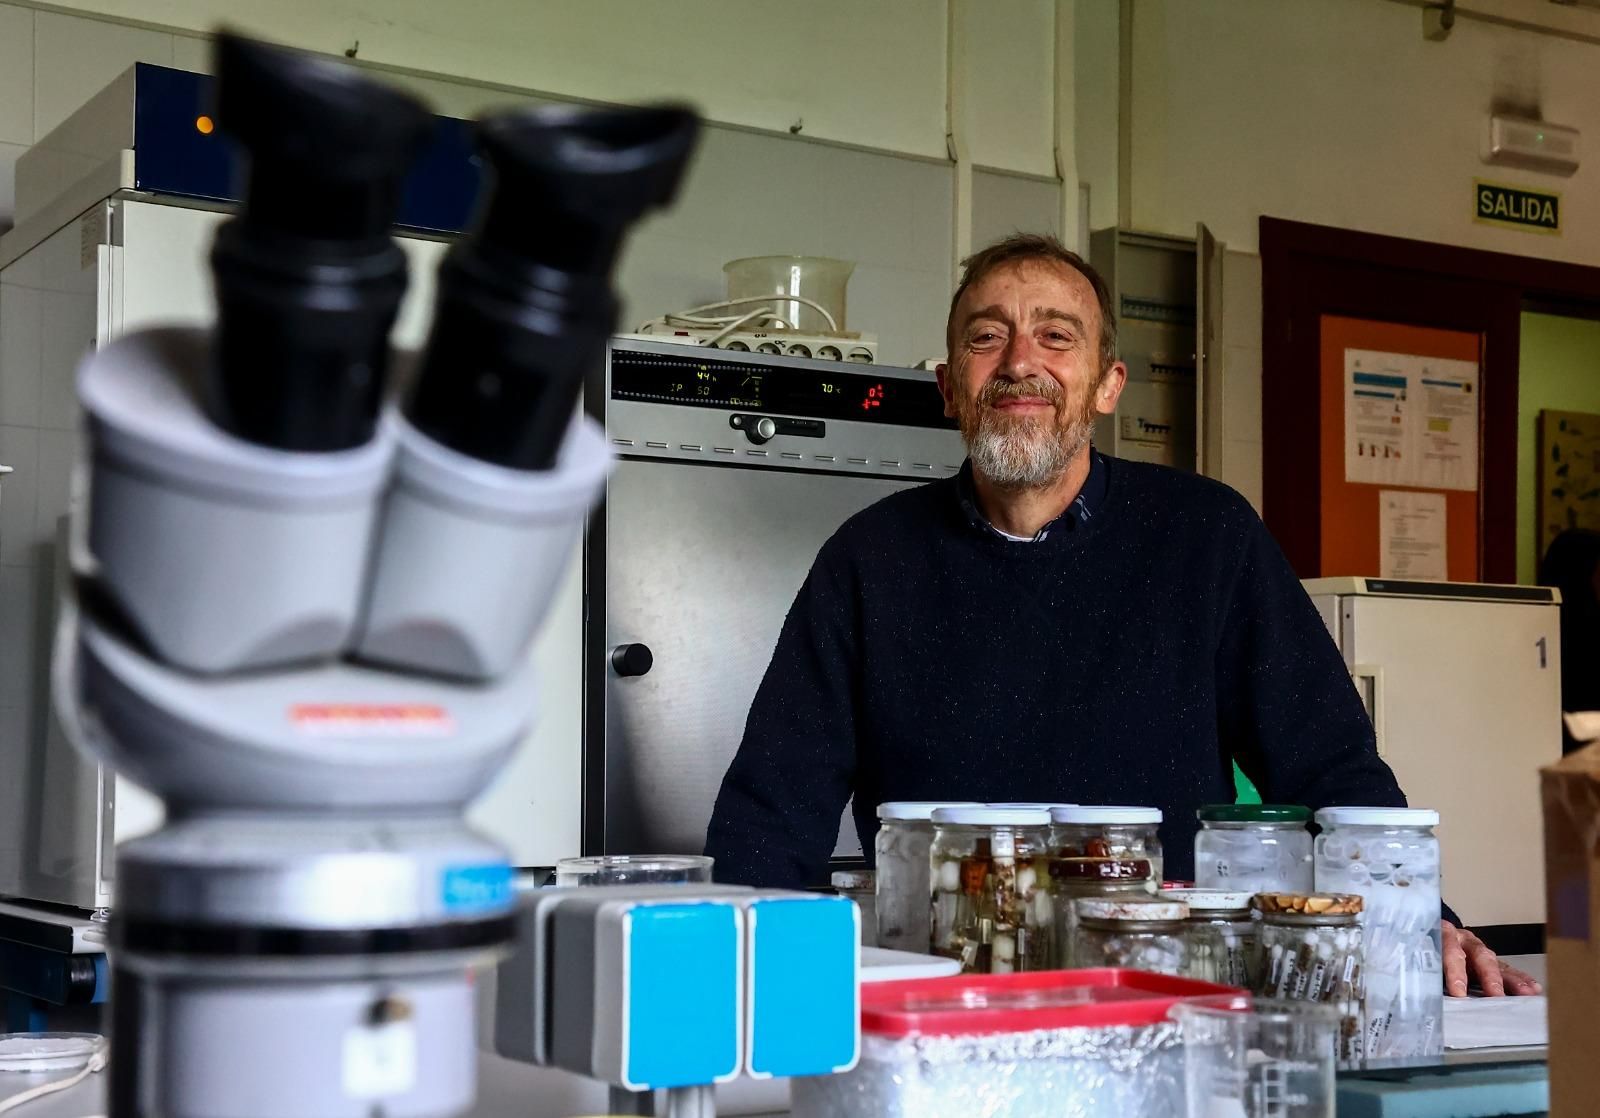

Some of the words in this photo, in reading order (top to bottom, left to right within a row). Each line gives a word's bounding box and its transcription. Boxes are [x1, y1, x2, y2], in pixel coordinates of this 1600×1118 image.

[1480, 190, 1555, 224] SALIDA
[697, 371, 710, 381] 44
[822, 383, 833, 393] 70
[1535, 636, 1547, 669] 1
